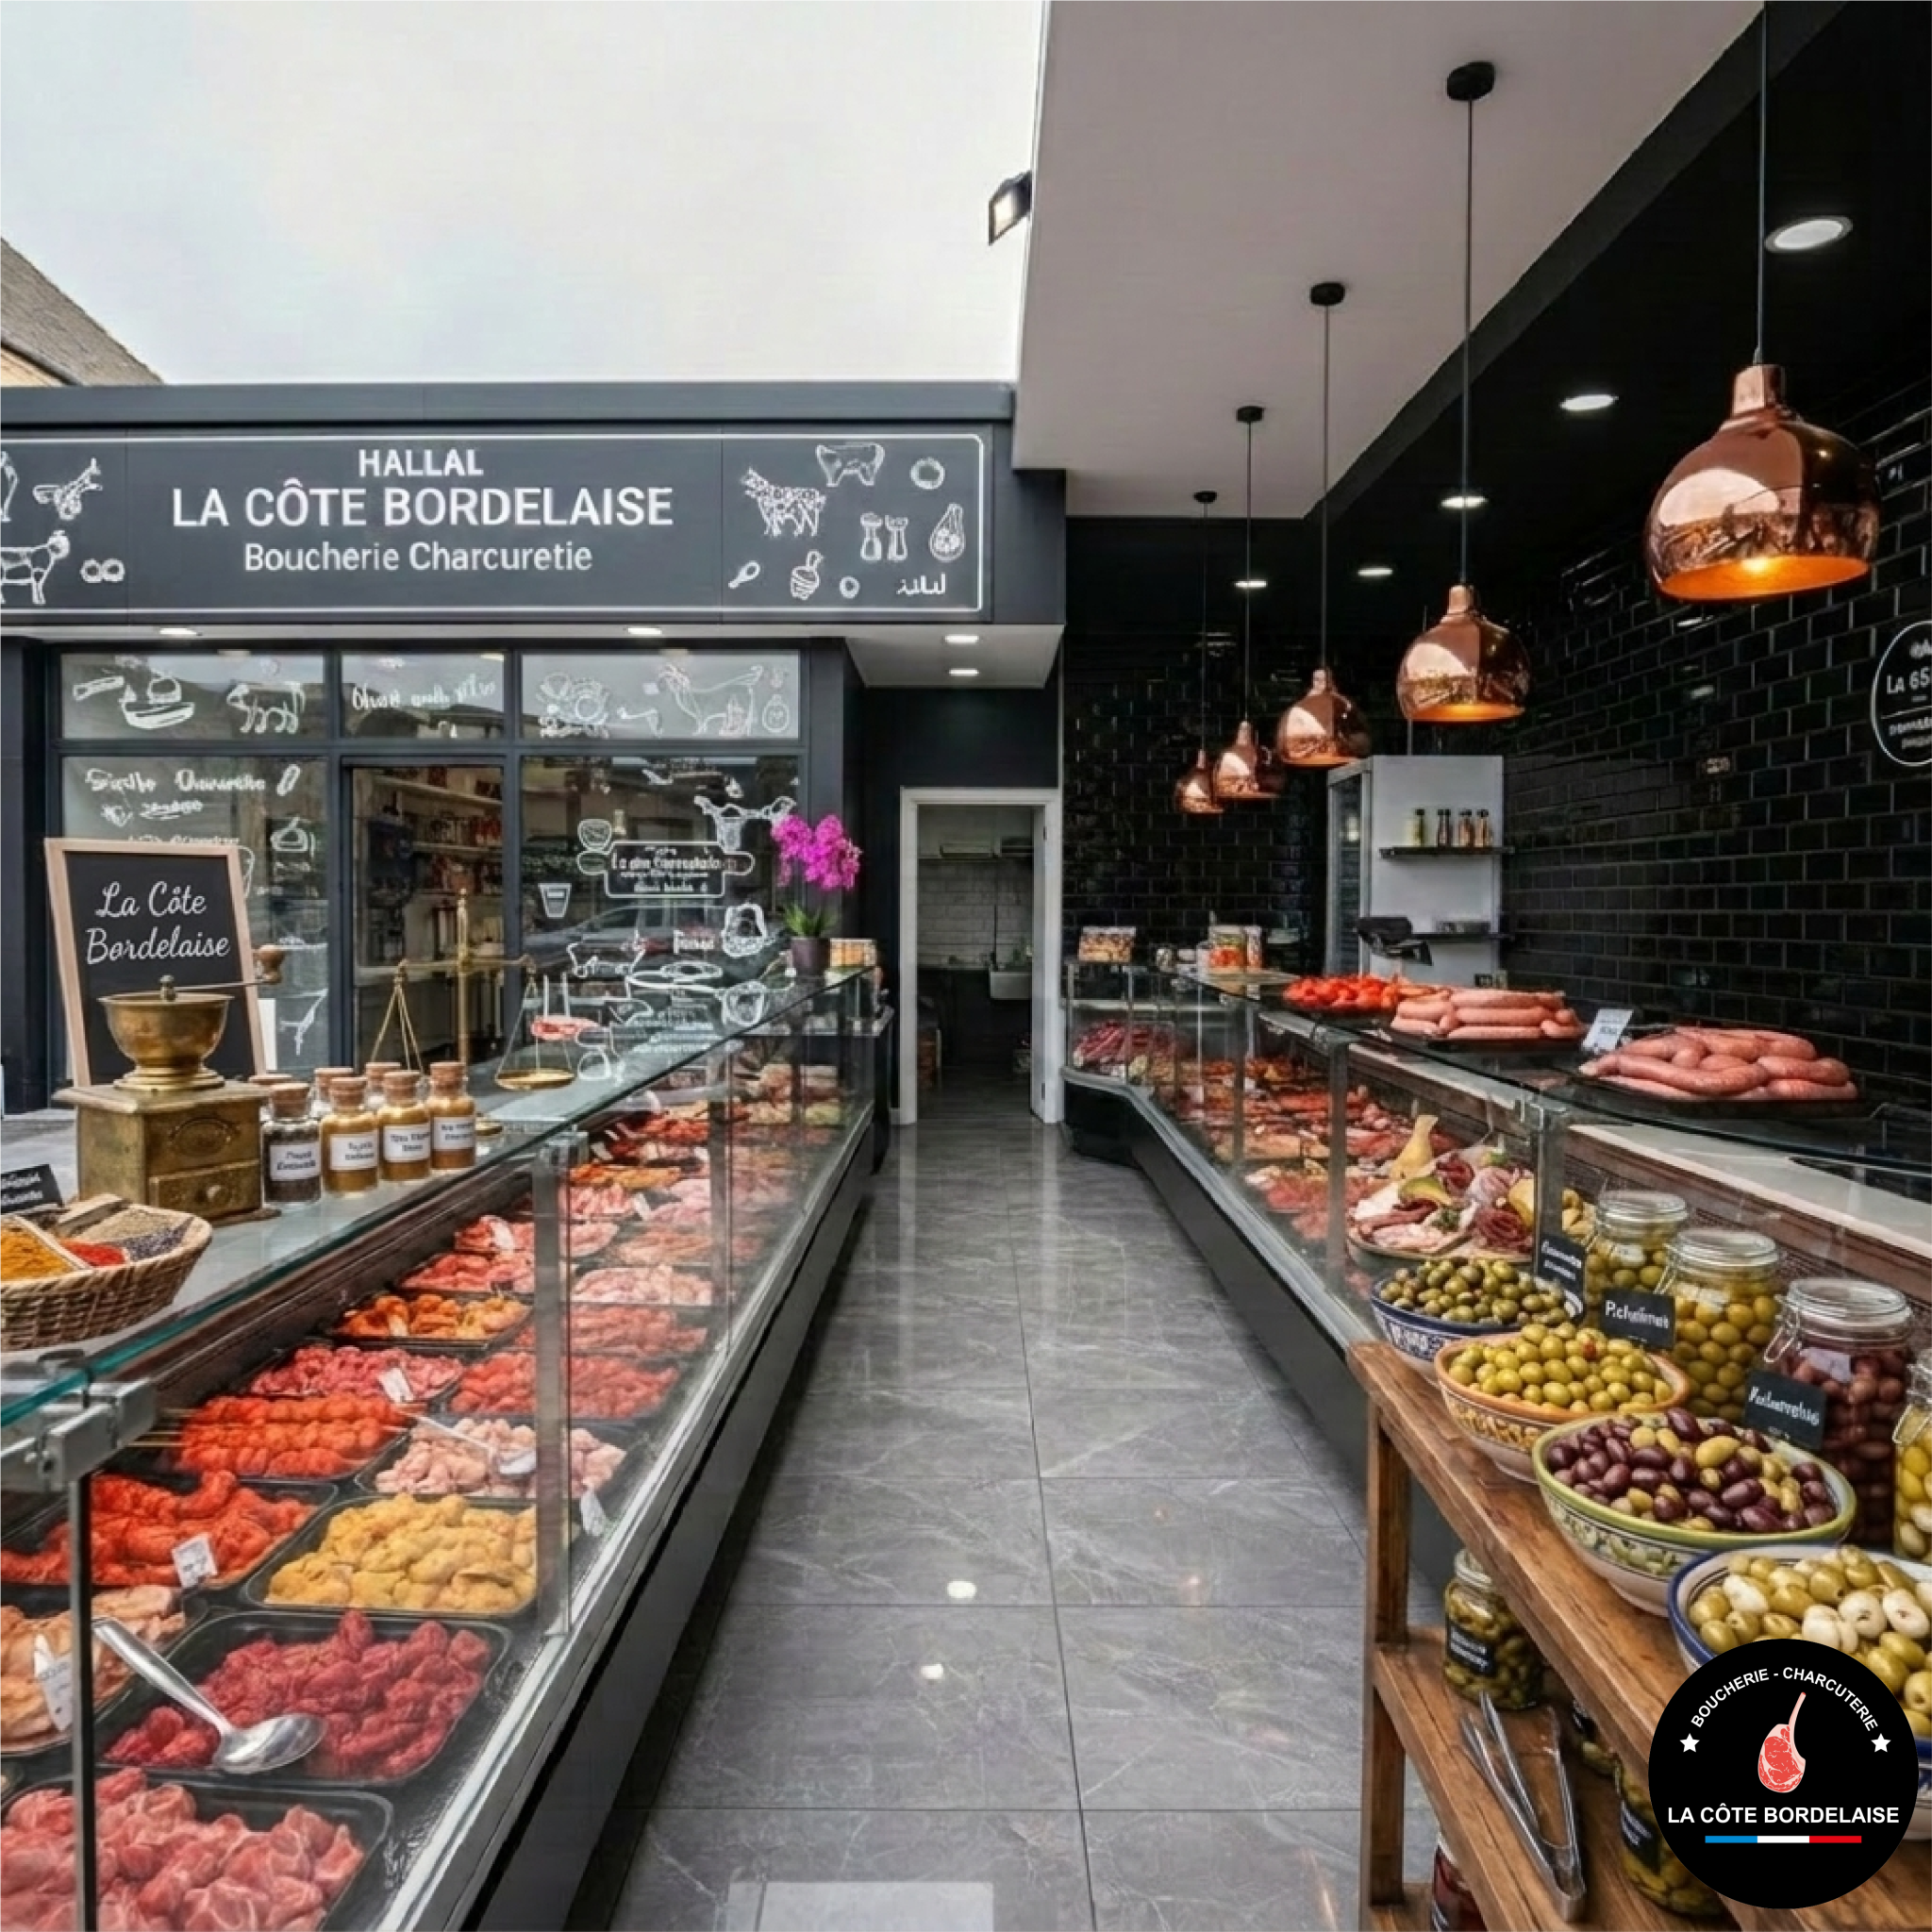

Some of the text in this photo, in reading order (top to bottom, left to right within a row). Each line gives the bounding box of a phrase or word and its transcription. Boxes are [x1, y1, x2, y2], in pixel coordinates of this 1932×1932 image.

[358, 448, 484, 477] HALLAL
[173, 477, 675, 527] LA CÔTE BORDELAISE
[244, 541, 593, 571] Boucherie Charcuretie
[95, 880, 208, 918] La Côte
[85, 924, 231, 965] Bordelaise
